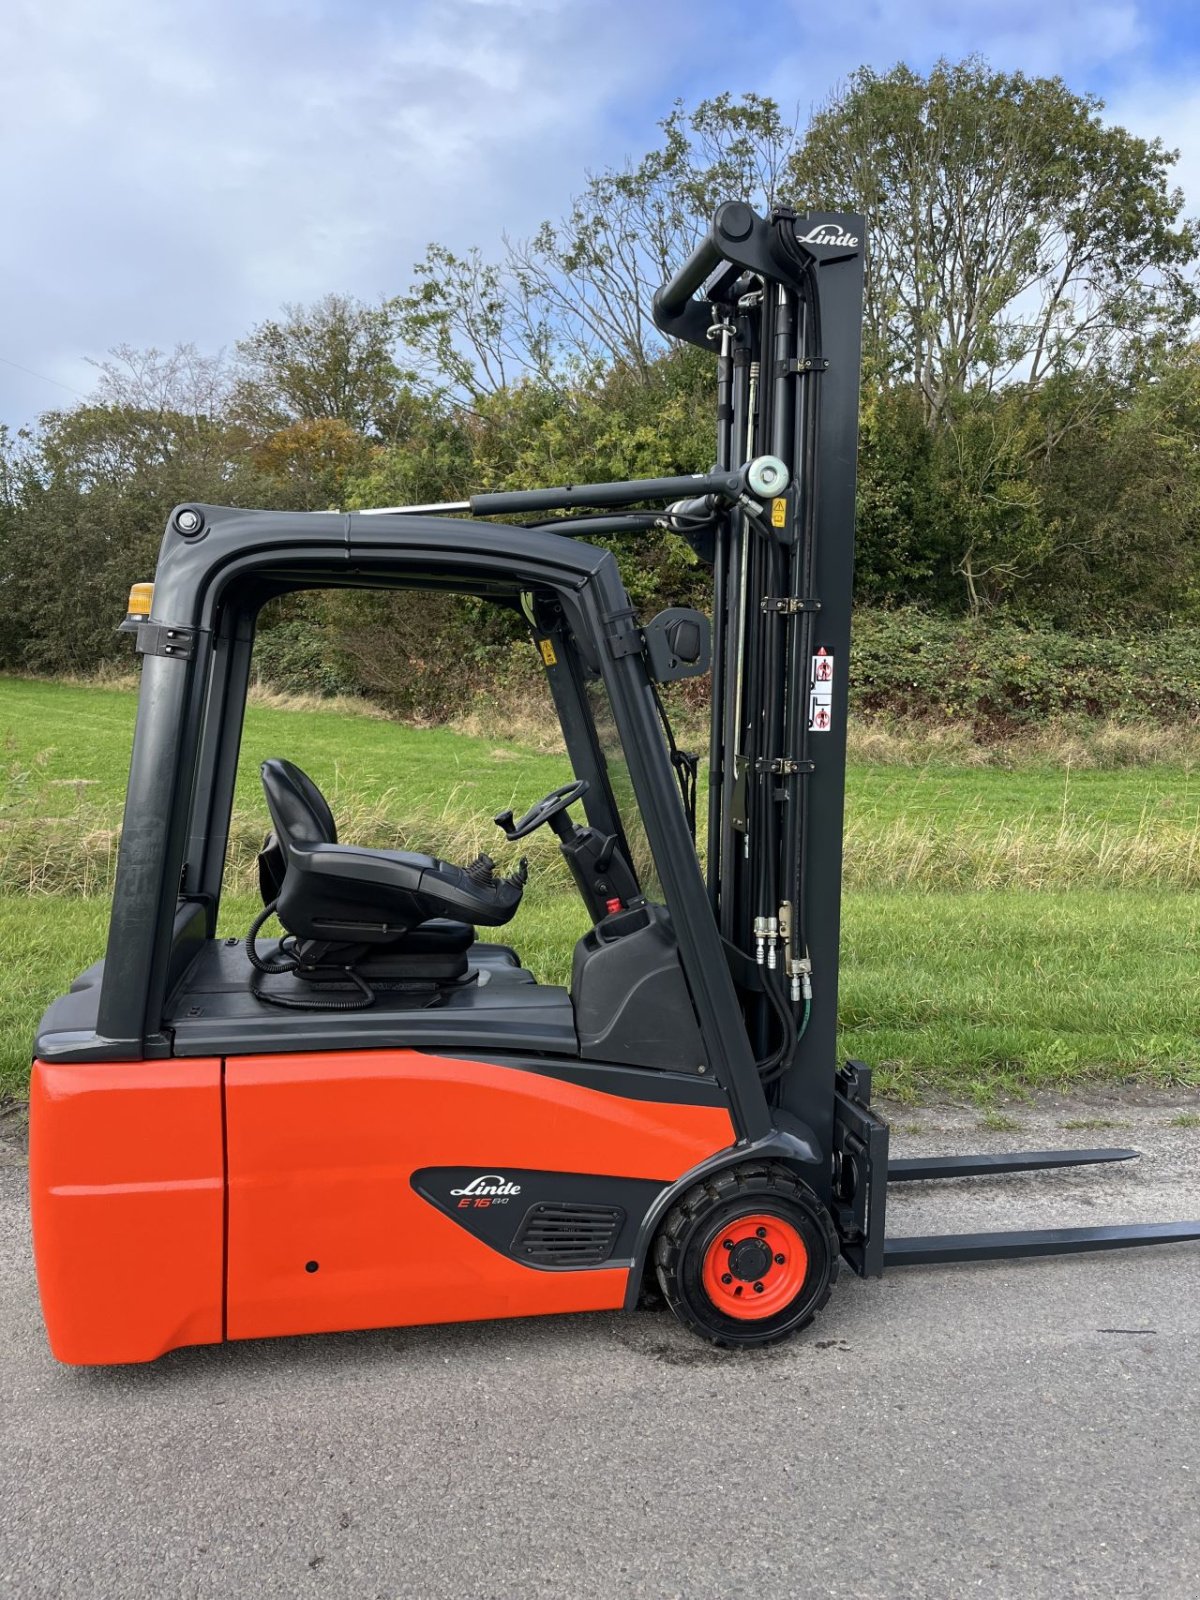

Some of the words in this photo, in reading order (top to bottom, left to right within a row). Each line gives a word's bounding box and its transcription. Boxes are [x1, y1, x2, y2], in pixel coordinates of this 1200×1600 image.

[795, 224, 859, 247] Linde
[450, 1174, 521, 1196] Linde
[457, 1198, 473, 1208] E
[473, 1198, 493, 1208] 16
